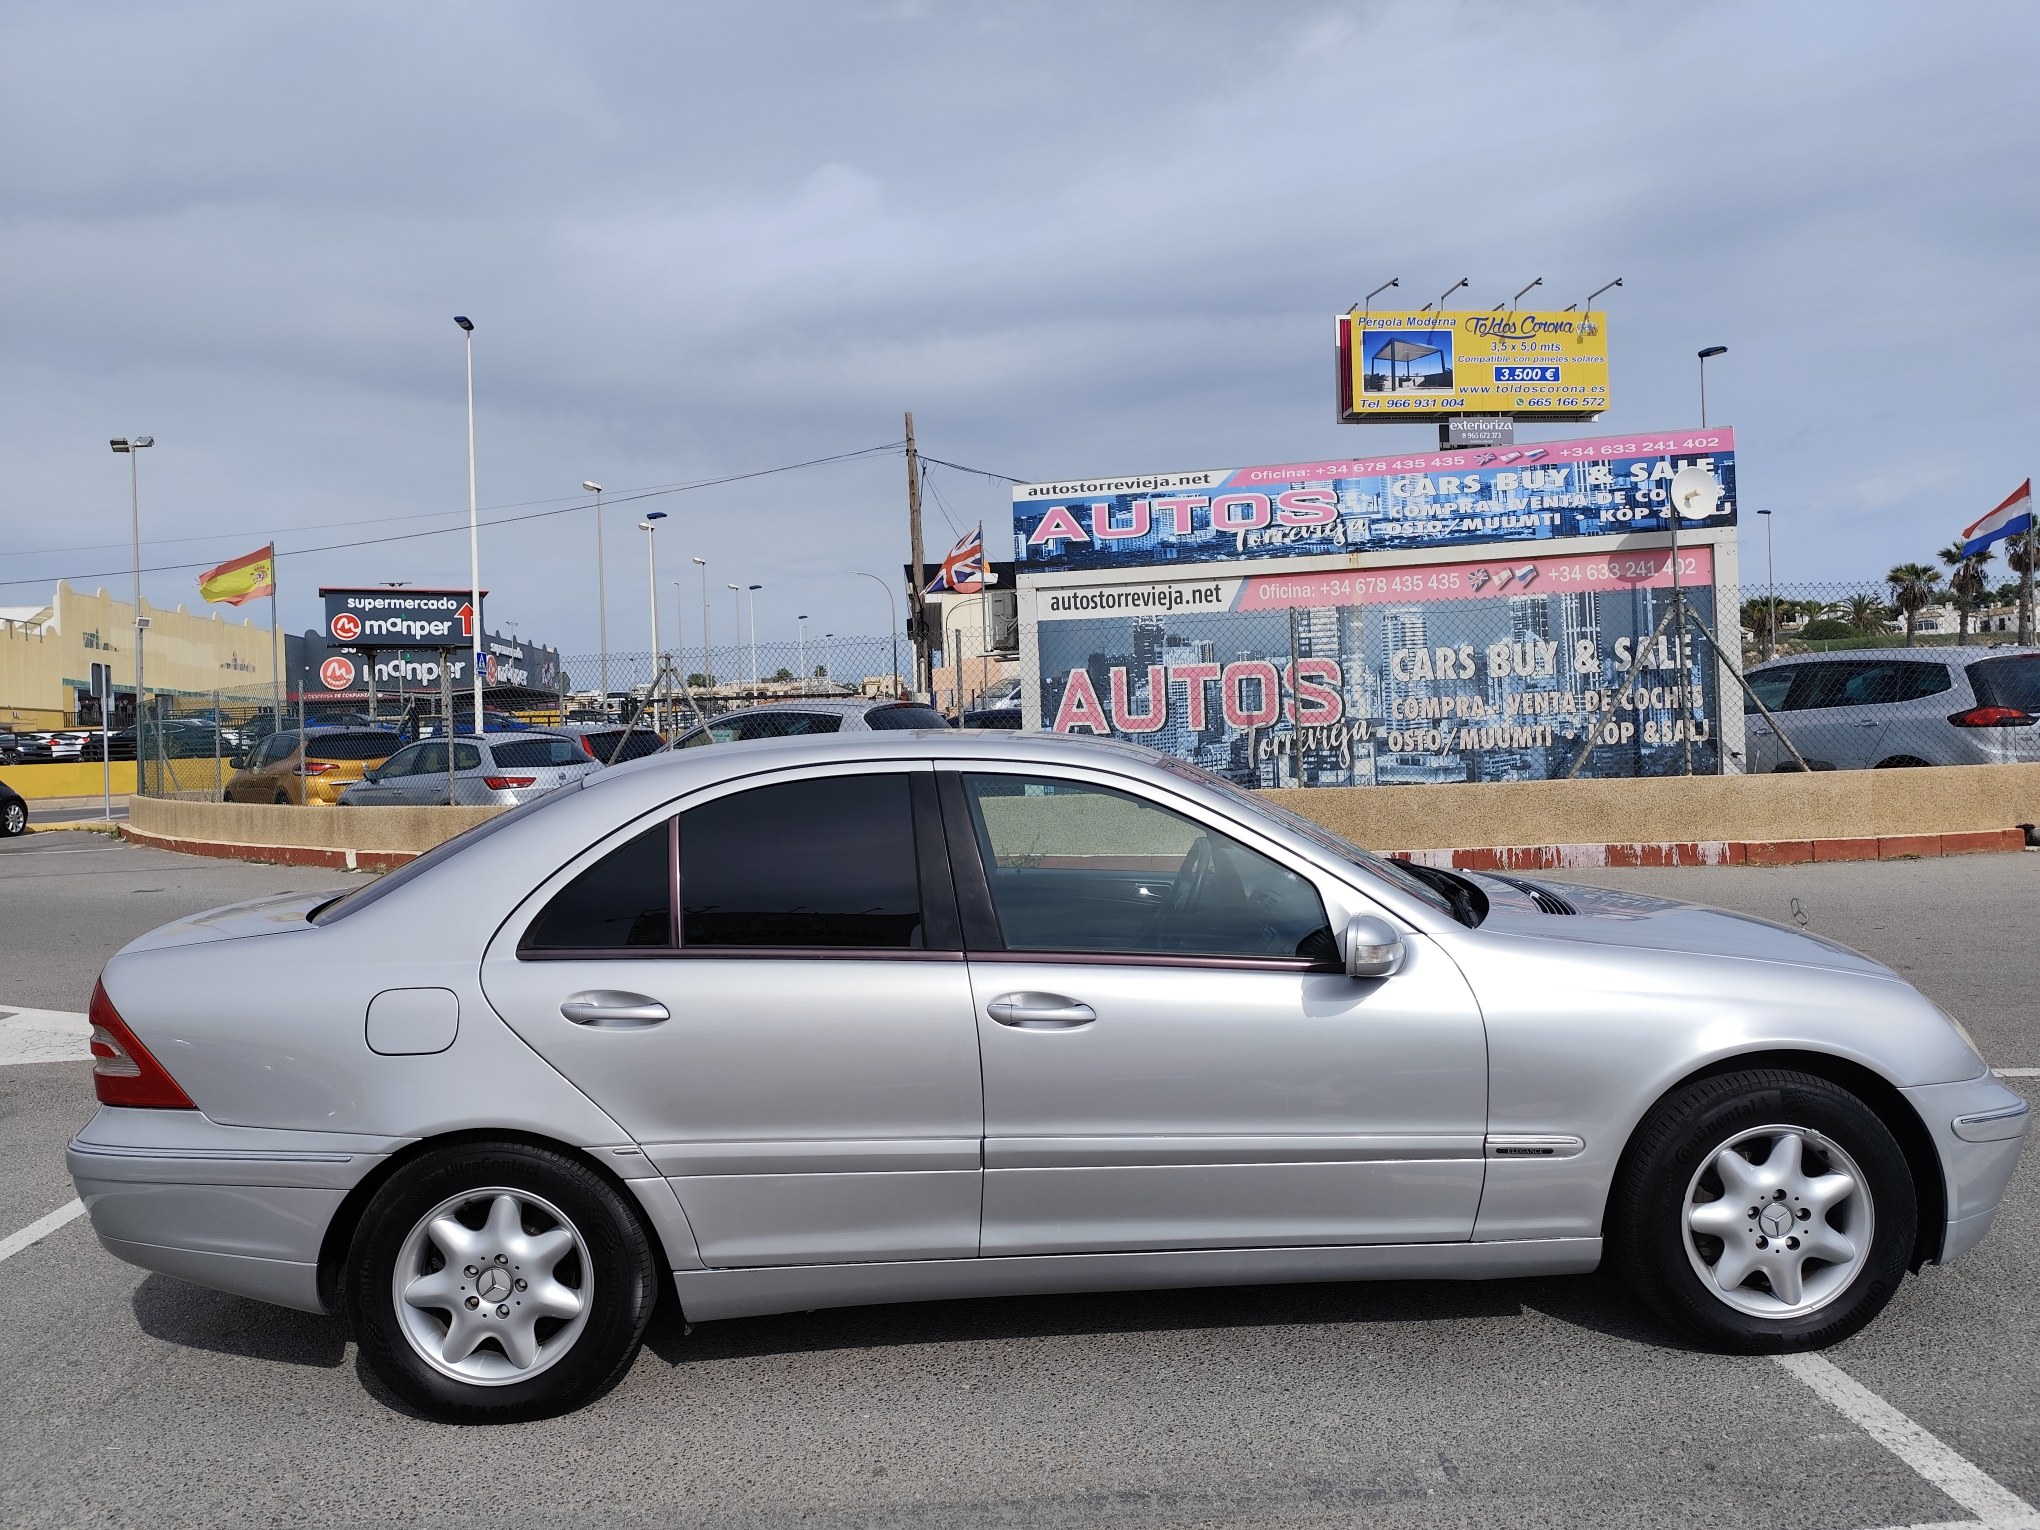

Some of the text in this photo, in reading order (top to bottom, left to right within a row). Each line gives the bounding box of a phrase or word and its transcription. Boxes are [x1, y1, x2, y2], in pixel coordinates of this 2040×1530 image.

[1358, 317, 1456, 328] Pérgola Moderna
[1521, 316, 1574, 334] Corona
[1491, 342, 1507, 352] 3,5
[1521, 342, 1537, 352] 5,0
[1540, 342, 1564, 351] mts.
[1458, 355, 1510, 363] Compatible
[1533, 355, 1568, 364] paneles
[1572, 355, 1604, 363] solares
[1501, 368, 1541, 380] 3.500
[1459, 384, 1605, 393] www.toldoscorona.es
[1360, 399, 1464, 408] Tel. 966 931 004
[1528, 398, 1605, 407] 665 166 572
[1450, 420, 1512, 430] exterioriza
[1560, 437, 1719, 457] +34 633 241 402
[1251, 456, 1464, 480] Oficina: +34 678 435 435
[1028, 473, 1211, 497] autostorrevieja.net
[1392, 474, 1482, 498] CARS
[1496, 467, 1571, 491] BUY
[1587, 465, 1614, 485] &
[1597, 491, 1626, 505] DE
[1027, 488, 1338, 545] AUTOS
[1601, 505, 1649, 522] KÖP
[1236, 518, 1369, 552] Torrevieja
[1549, 566, 1582, 582] +34
[1586, 563, 1621, 580] 633
[1626, 560, 1657, 578] 241
[1259, 573, 1460, 600] Oficina: +34 678 435 435
[347, 597, 457, 611] supermercado
[1051, 584, 1222, 611] autostorrevieja.net
[365, 617, 452, 640] manper
[1392, 645, 1476, 682] CARS
[1489, 641, 1559, 678] BUY
[1574, 638, 1601, 674] &
[1052, 658, 1344, 734] AUTOS
[1392, 695, 1486, 719] COMPRA
[1507, 691, 1577, 715] VENTA
[1585, 689, 1612, 712] DE
[1240, 719, 1373, 769] Torrevieja
